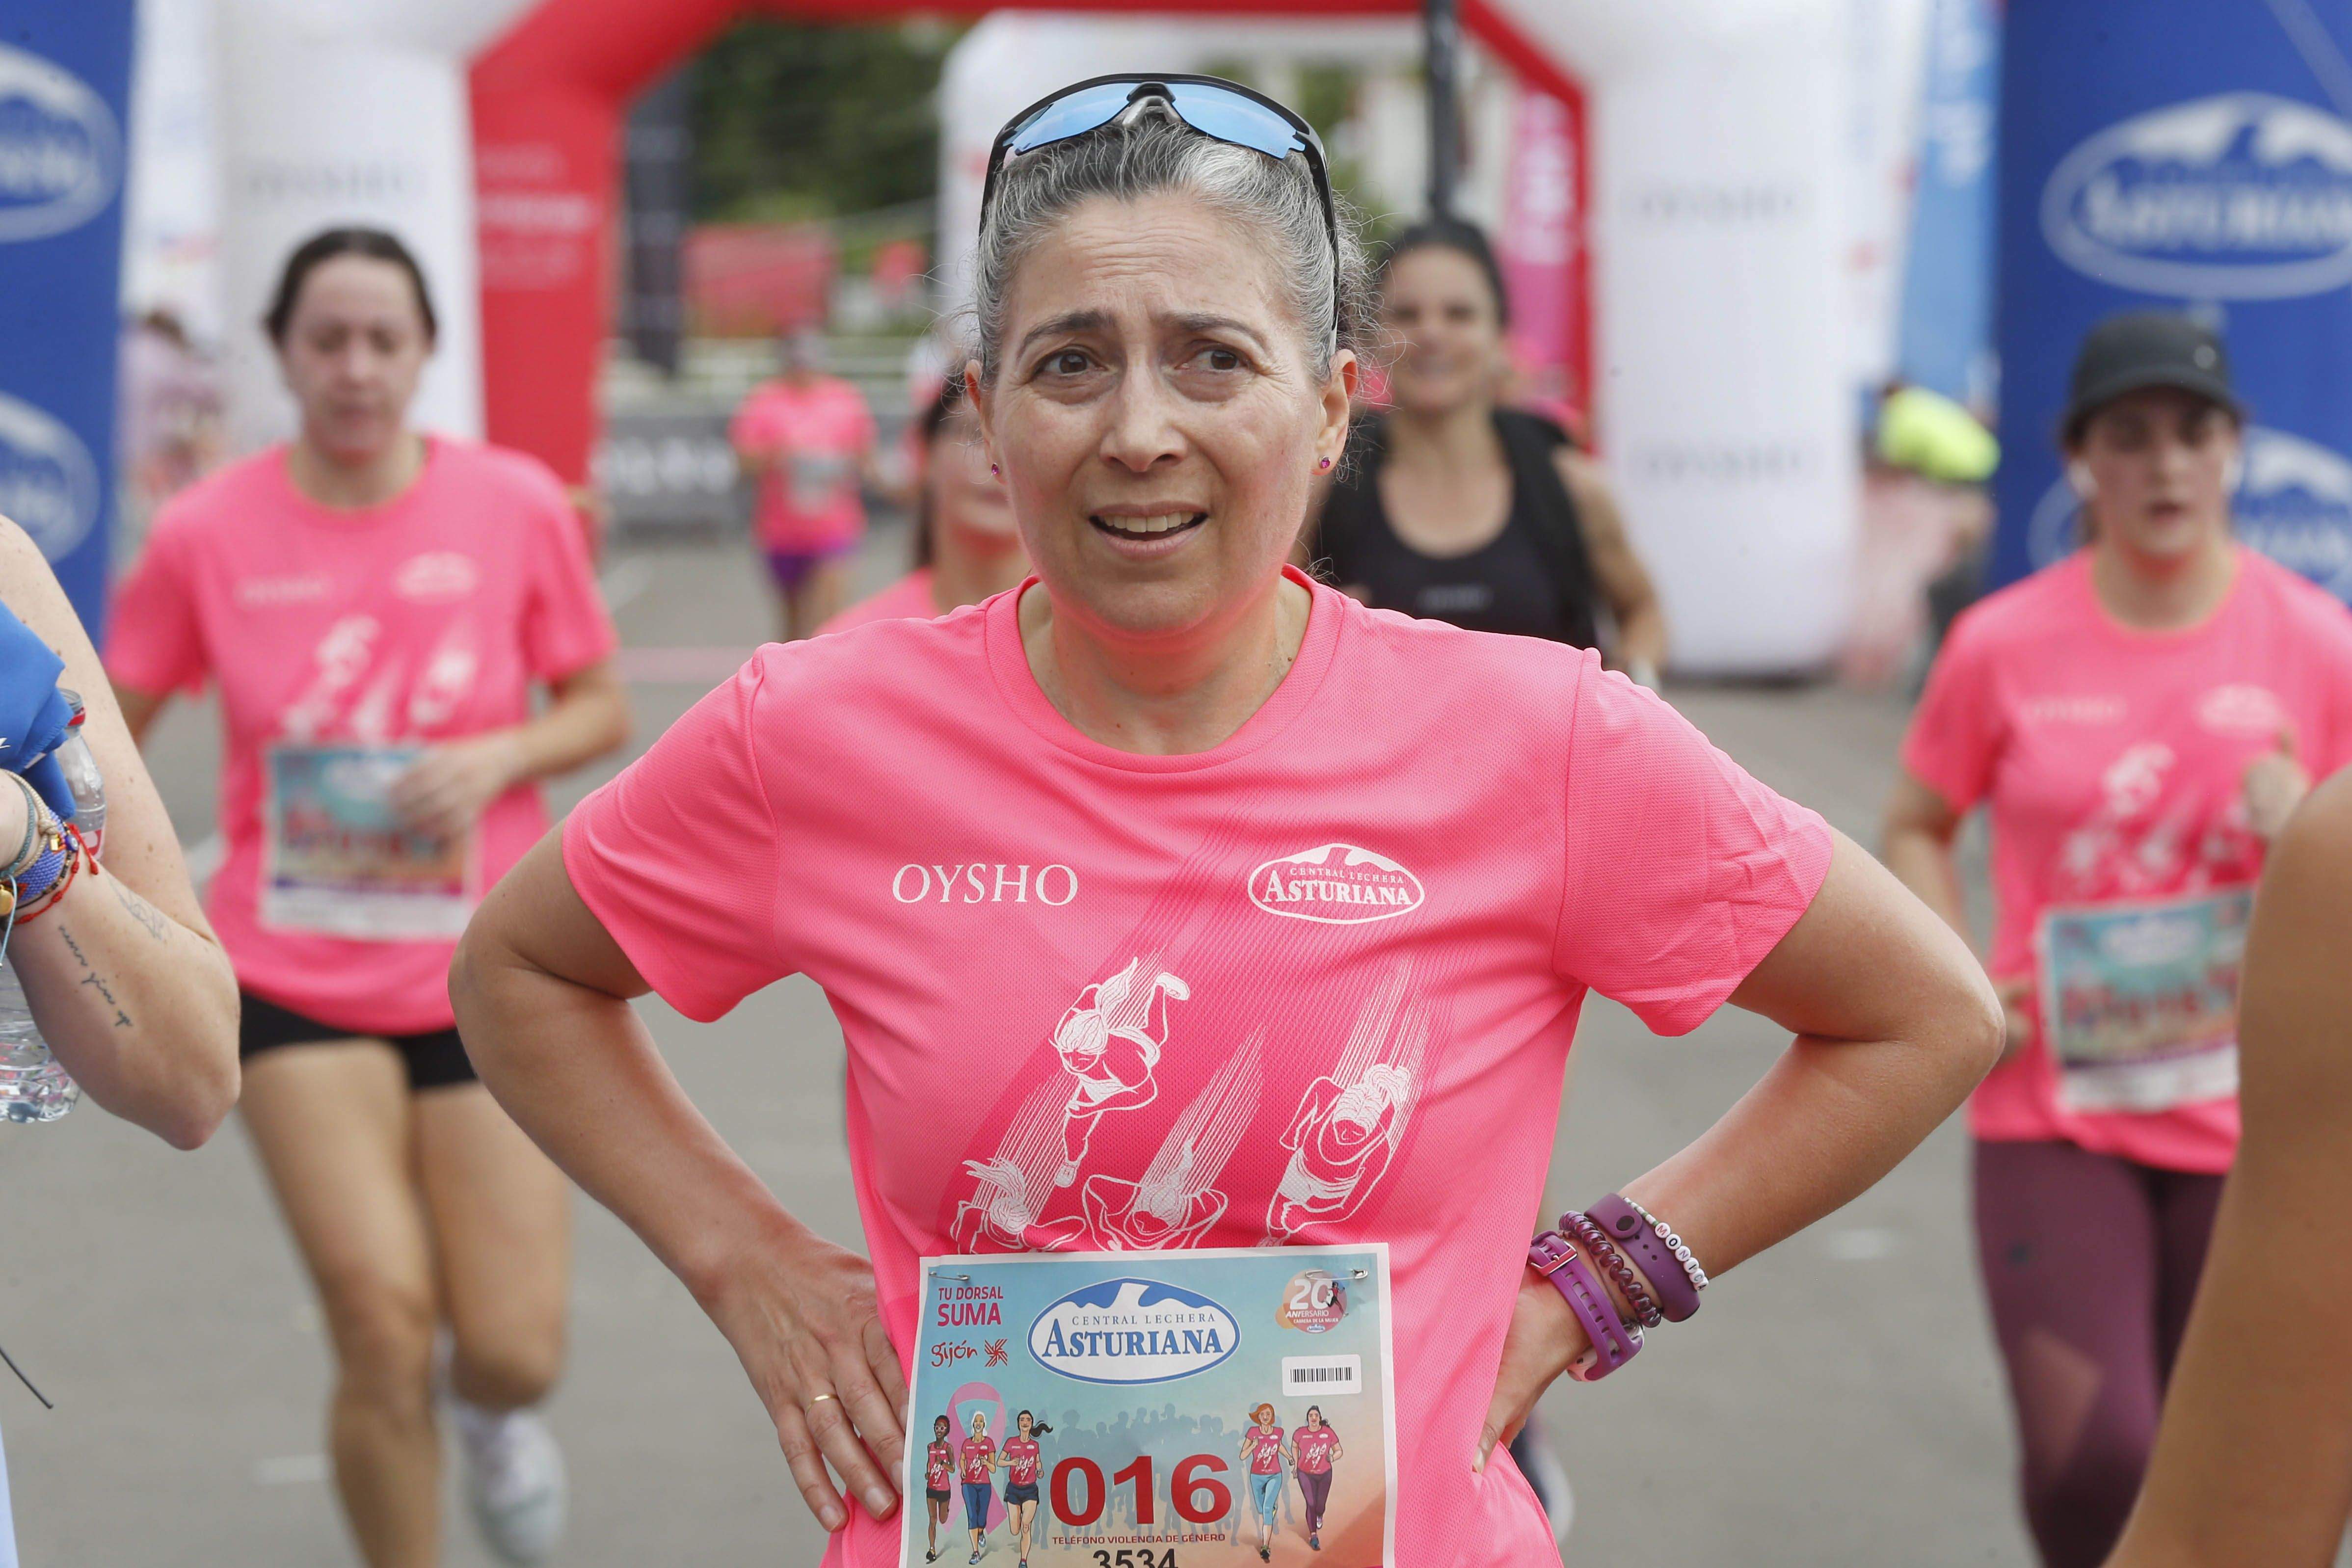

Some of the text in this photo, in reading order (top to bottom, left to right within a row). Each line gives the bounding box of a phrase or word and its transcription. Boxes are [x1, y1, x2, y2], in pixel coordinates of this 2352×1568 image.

[892, 863, 1078, 906] OYSHO
[1262, 869, 1413, 905] ASTURIANA
[1290, 867, 1404, 884] CENTRAL LECHERA
[938, 1286, 1004, 1301] TU DORSAL
[1290, 1278, 1334, 1310] 20
[937, 1302, 1001, 1327] SUMA
[1072, 1313, 1216, 1326] CENTRAL LECHERA
[1042, 1318, 1224, 1357] ASTURIANA
[931, 1339, 978, 1368] gijón
[1050, 1454, 1232, 1526] 016
[1052, 1532, 1226, 1545] TELÉFONO VIOLENCIA DE GÉNERO
[1093, 1548, 1179, 1568] 3534
